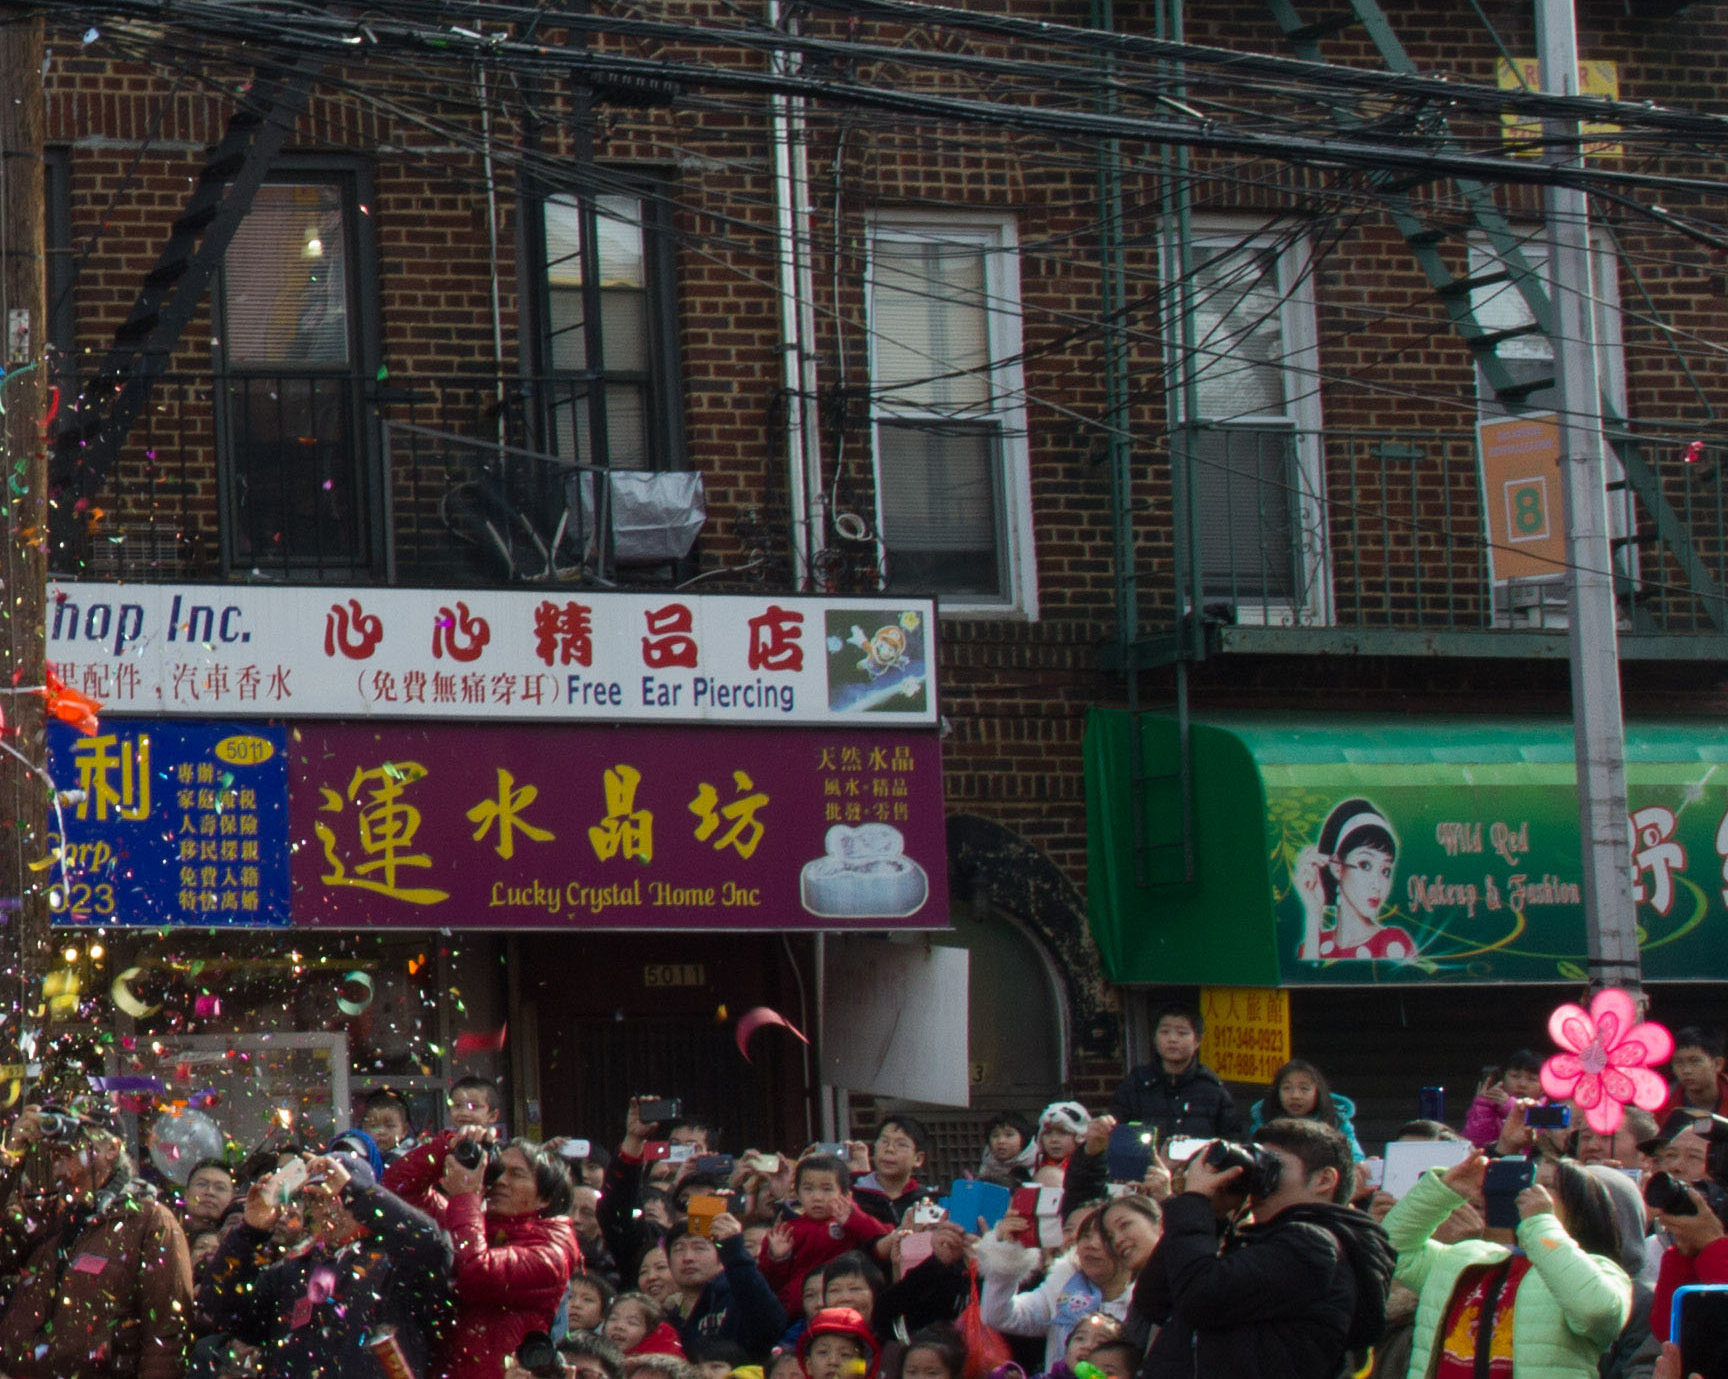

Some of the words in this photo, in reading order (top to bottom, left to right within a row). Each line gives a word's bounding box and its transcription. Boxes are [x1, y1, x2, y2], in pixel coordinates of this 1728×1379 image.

[51, 596, 144, 656] hop
[167, 595, 252, 643] Inc.
[324, 598, 805, 672] 心心精品店
[567, 674, 622, 706] Free
[642, 676, 682, 708] Ear
[693, 677, 795, 713] Piercing
[226, 743, 264, 759] 5011
[816, 746, 914, 772] 天然水晶
[1435, 821, 1484, 857] Wild
[1489, 821, 1531, 866] Red
[488, 880, 562, 913] Lucky
[566, 880, 641, 913] Crystal
[649, 881, 716, 908] Home
[1406, 874, 1478, 919] Makeup
[1507, 874, 1583, 914] Fashion
[647, 964, 703, 986] 5011
